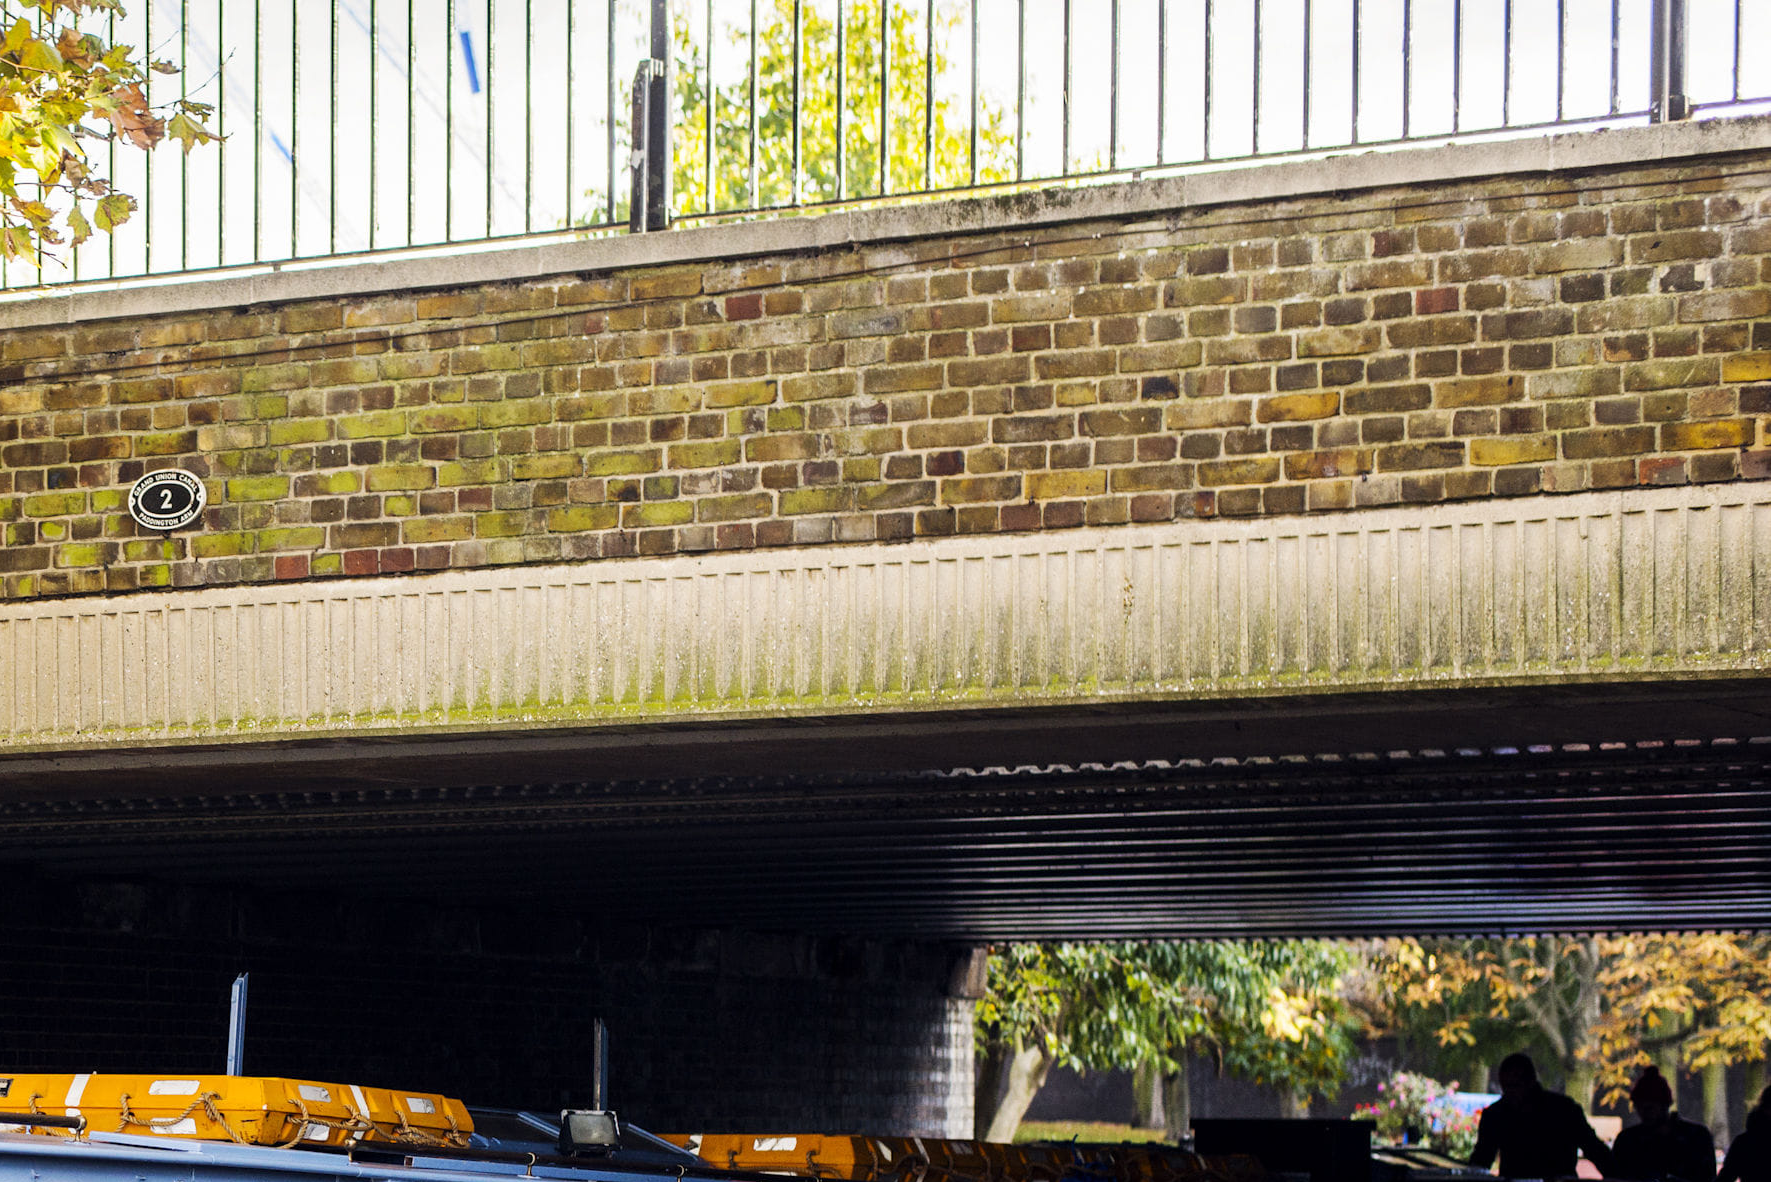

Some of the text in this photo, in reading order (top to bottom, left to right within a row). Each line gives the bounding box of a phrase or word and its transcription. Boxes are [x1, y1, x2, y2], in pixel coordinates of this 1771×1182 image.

[134, 477, 154, 496] GRAND
[179, 475, 197, 493] CANAL
[160, 489, 173, 509] 2
[139, 510, 194, 526] PADDINGTON ARM
